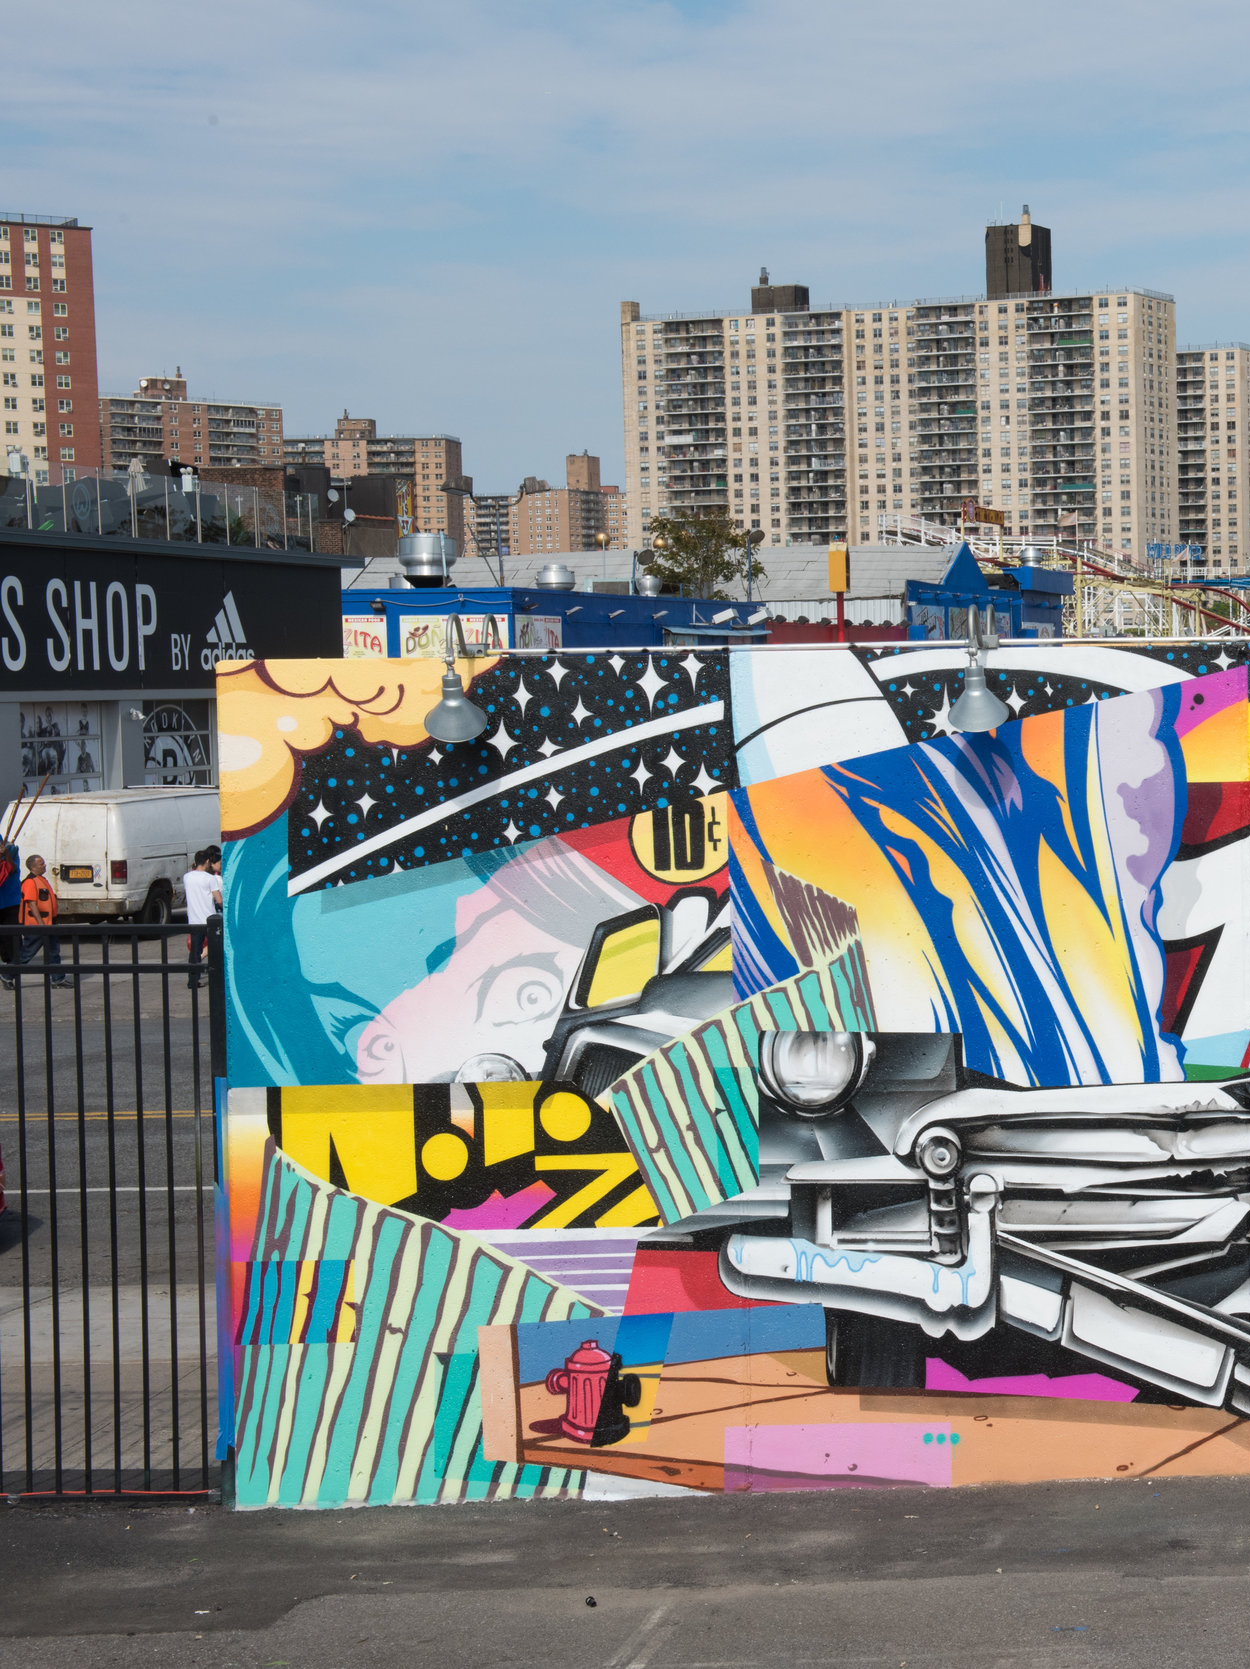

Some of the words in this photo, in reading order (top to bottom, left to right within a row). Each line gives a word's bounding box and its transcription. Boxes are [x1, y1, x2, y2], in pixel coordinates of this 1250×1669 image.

[46, 578, 157, 672] SHOP
[171, 633, 191, 671] BY
[200, 642, 256, 671] adidas
